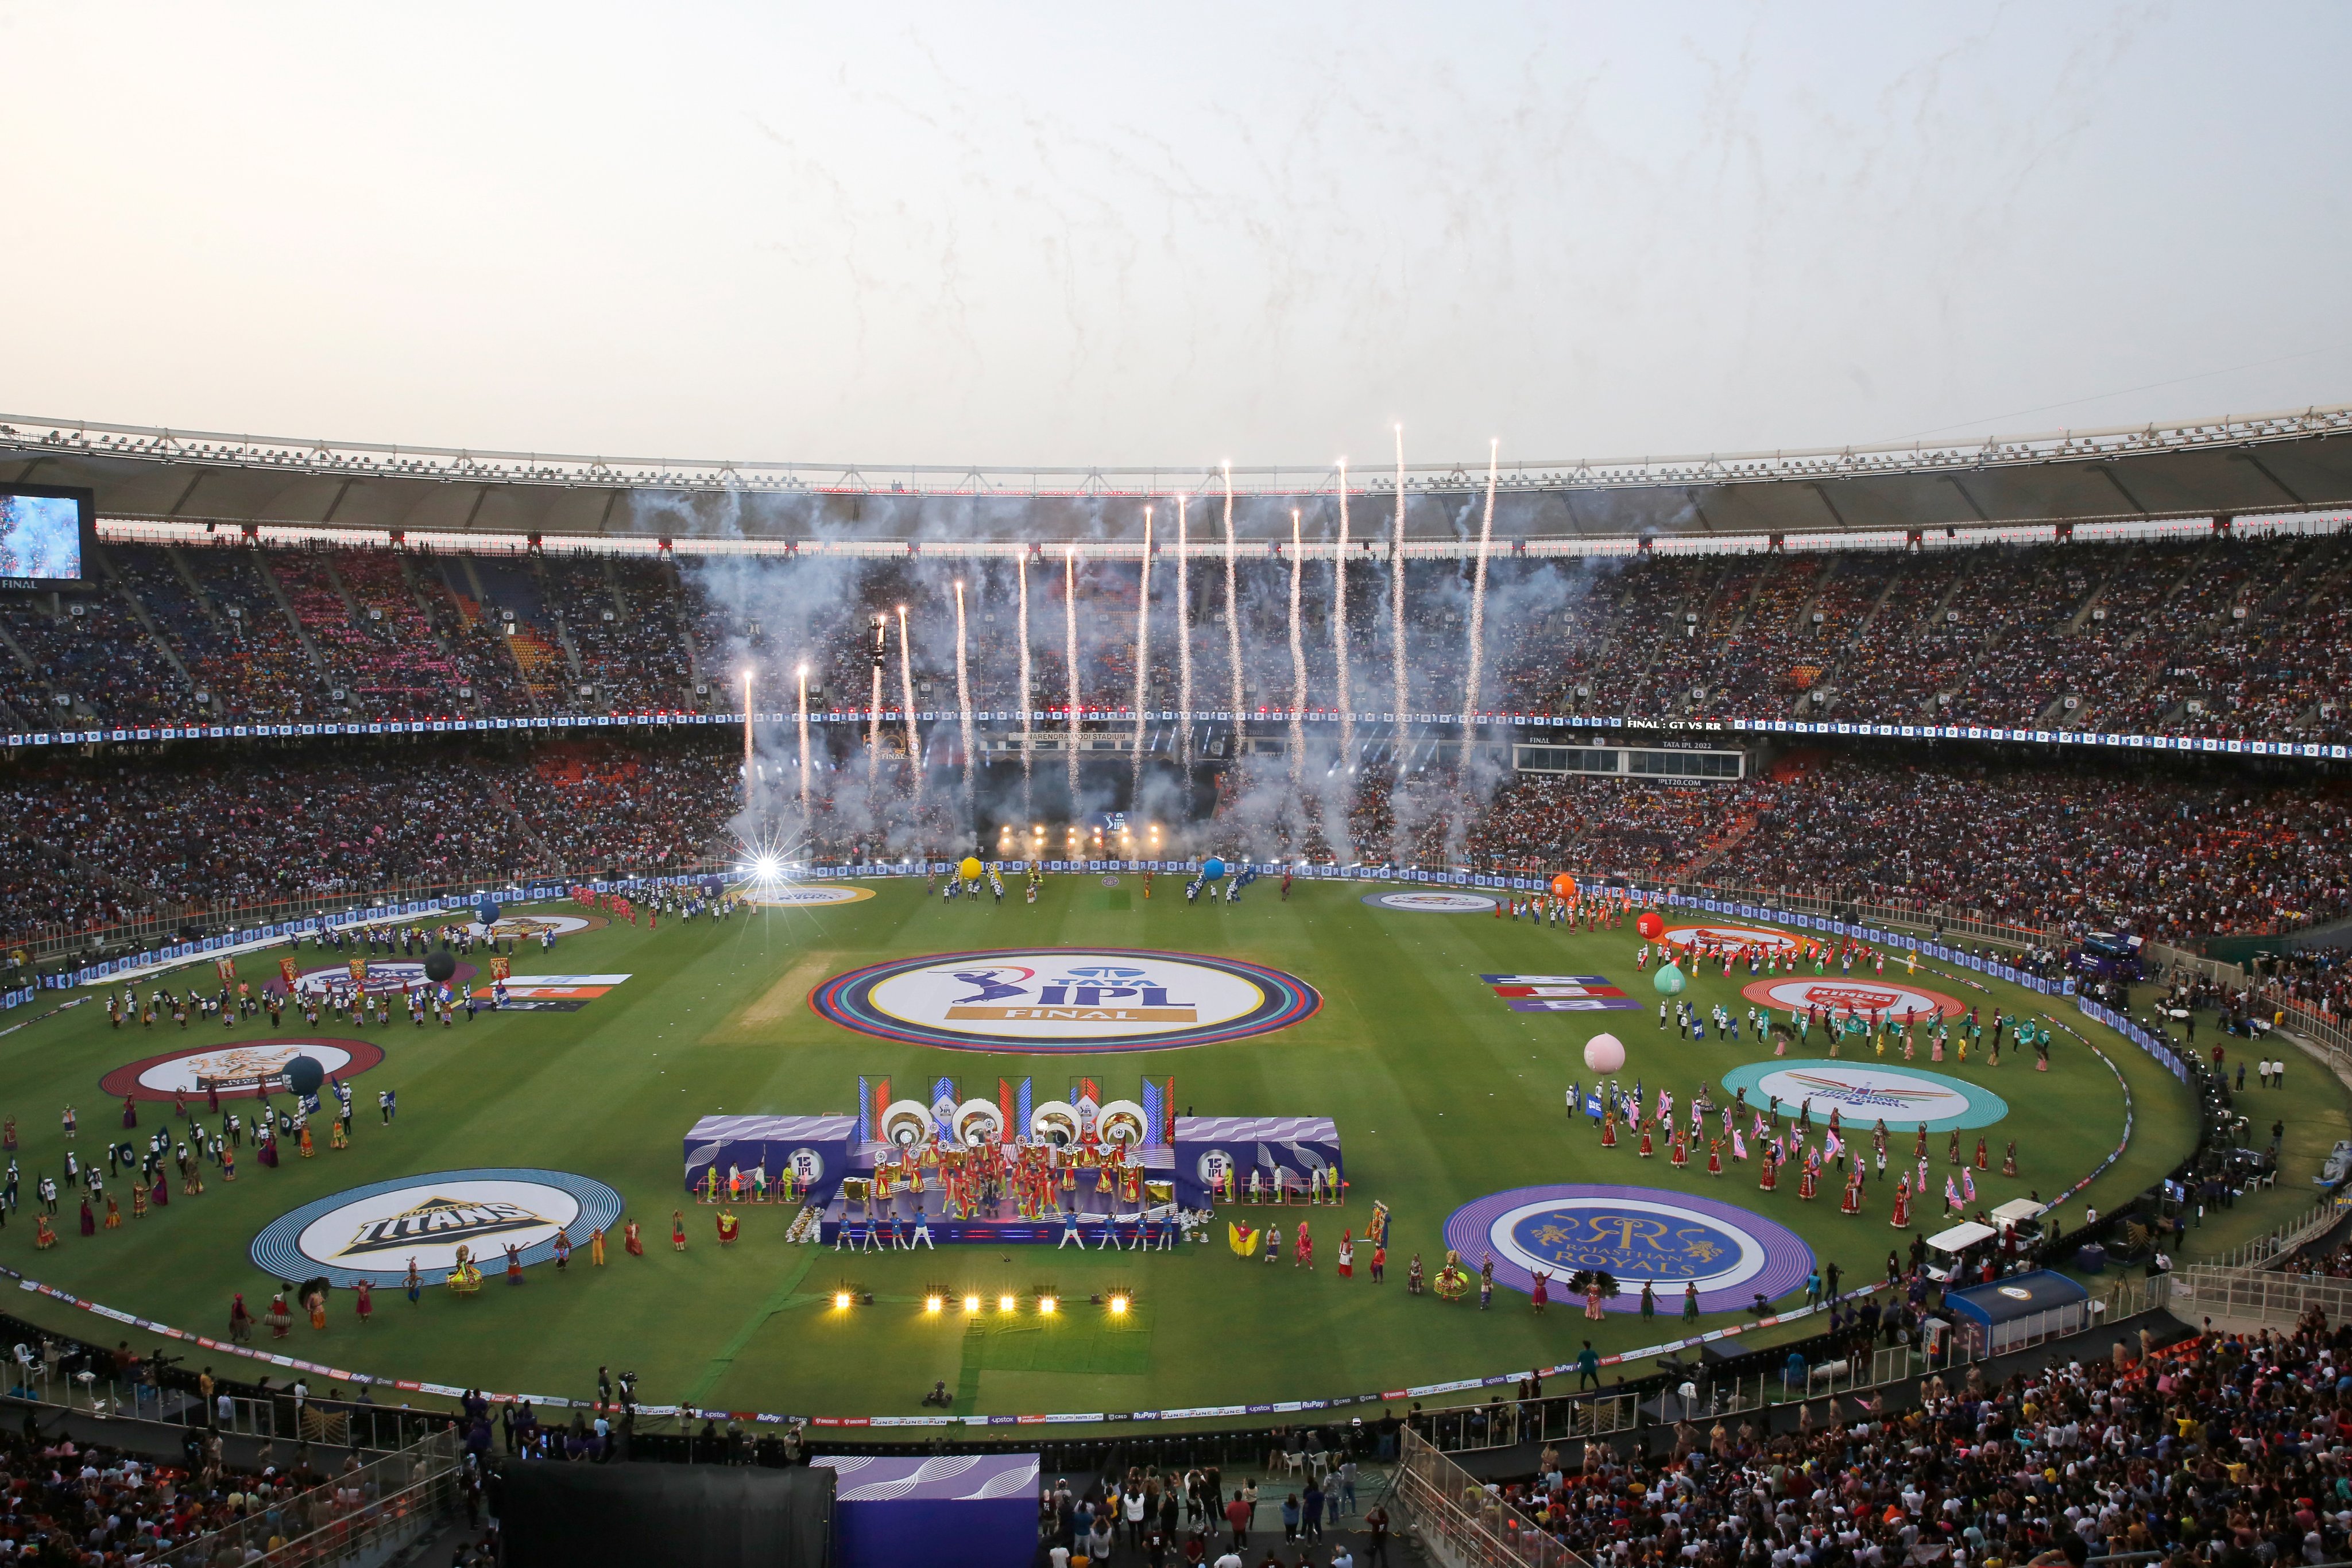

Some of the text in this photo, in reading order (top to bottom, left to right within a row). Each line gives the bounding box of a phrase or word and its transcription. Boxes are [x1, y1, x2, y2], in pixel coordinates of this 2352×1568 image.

[2, 580, 37, 589] FINAL
[1627, 720, 1659, 728] FINAL
[1046, 978, 1159, 986] TATA
[1038, 986, 1196, 1006] IPL
[1812, 989, 1892, 1002] KINGS
[1005, 1009, 1138, 1020] FINAL
[1805, 1092, 1909, 1108] SUPER GIANTS
[1819, 1090, 1899, 1103] LUCKNOW
[797, 1157, 811, 1167] 15
[1208, 1159, 1222, 1168] 15
[798, 1167, 813, 1175] IPL
[1208, 1169, 1222, 1177] IPL
[400, 1203, 477, 1217] GUJARAT
[351, 1202, 537, 1244] TITANS
[1566, 1244, 1682, 1262] RAJASTHAN
[1554, 1250, 1695, 1276] ROYALS
[1554, 1364, 1573, 1373] RuPay
[350, 1373, 370, 1383] RuPay
[1486, 1376, 1504, 1384] upstox
[757, 1414, 780, 1423] RuPay
[1134, 1411, 1157, 1419] RuPay
